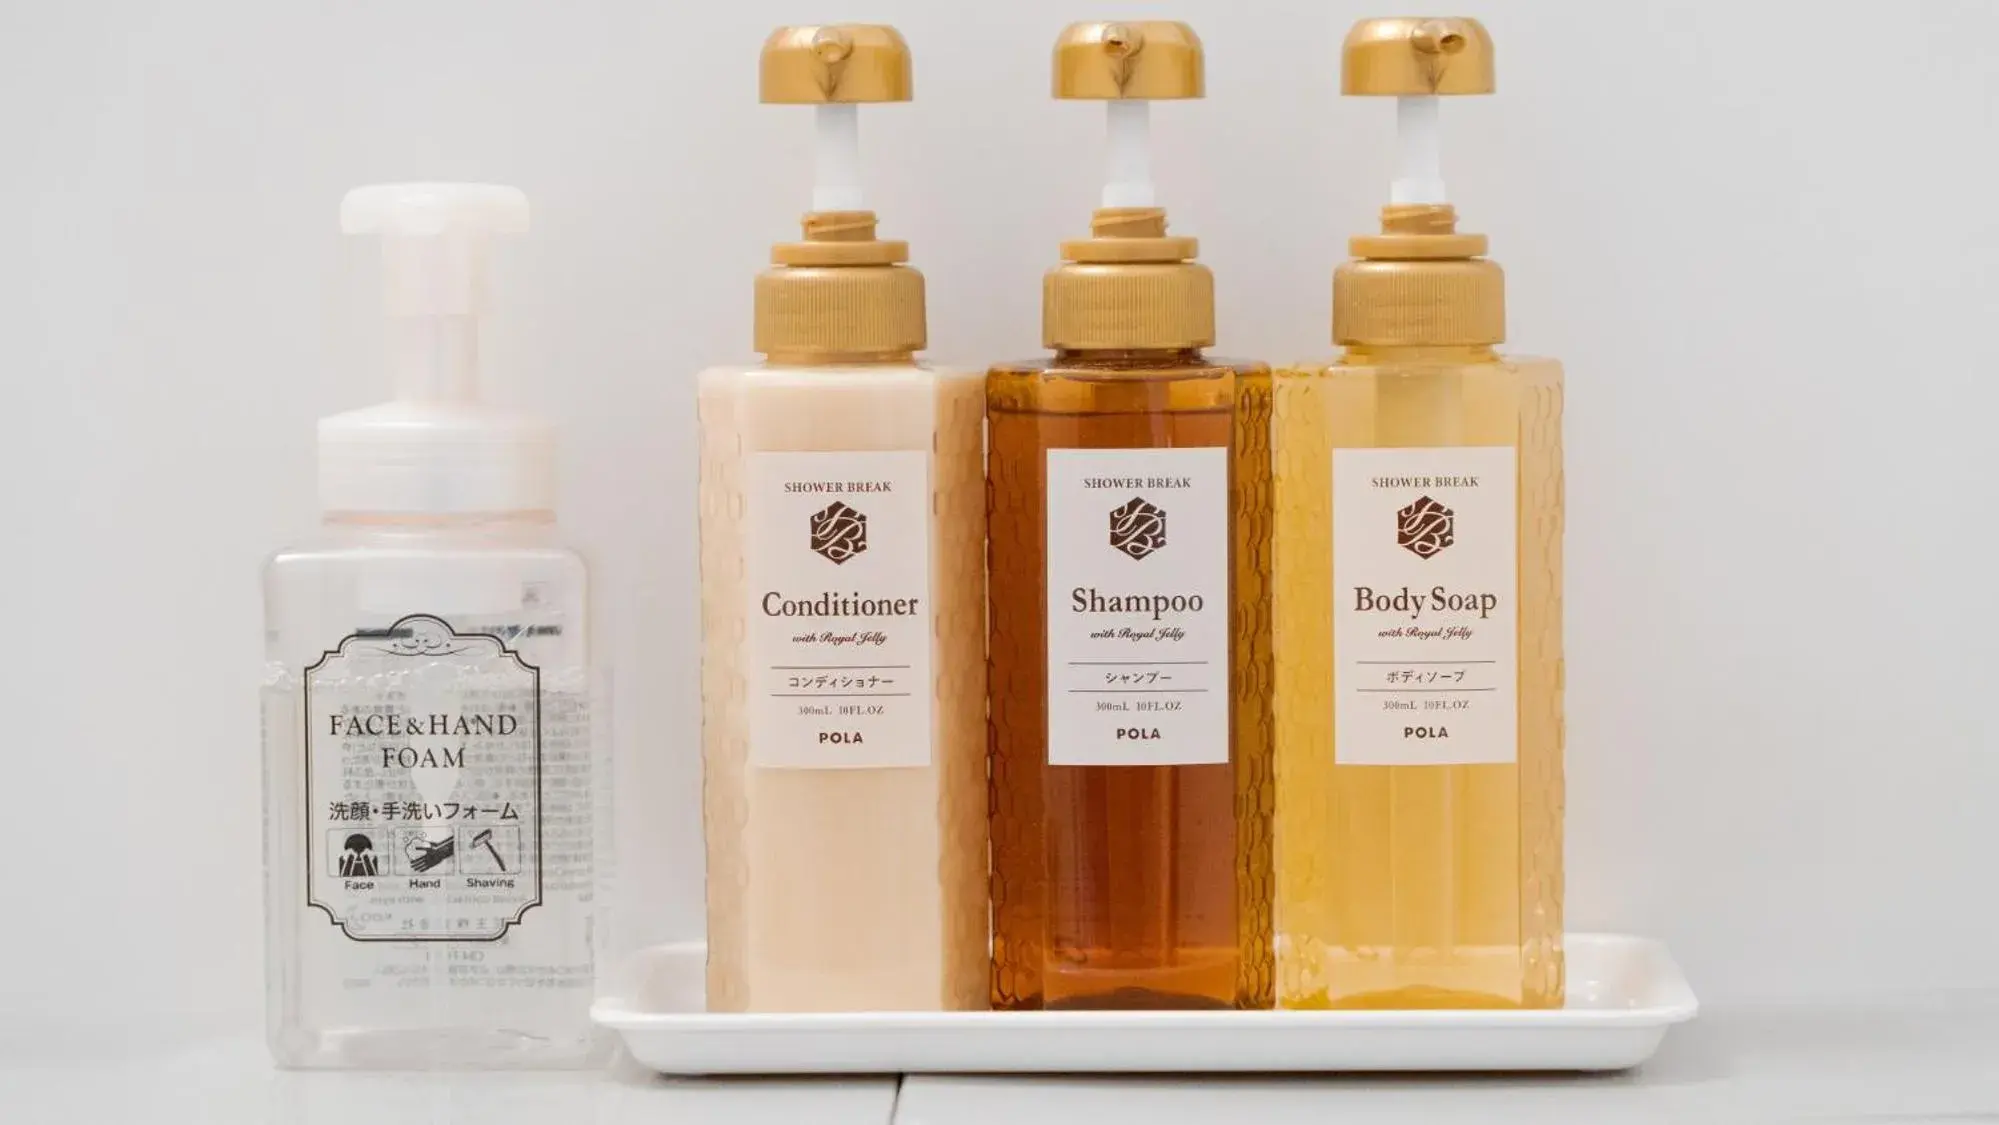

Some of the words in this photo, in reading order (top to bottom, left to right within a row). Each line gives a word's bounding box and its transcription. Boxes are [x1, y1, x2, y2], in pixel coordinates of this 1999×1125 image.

[784, 482, 844, 493] SHOWER
[847, 482, 892, 493] BREAK
[1083, 477, 1143, 489] SHOWER
[1147, 477, 1191, 489] BREAK
[1371, 477, 1431, 488] SHOWER
[1435, 476, 1479, 488] BREAK
[761, 591, 919, 617] Conditioner
[1072, 587, 1204, 621] Shampoo
[1353, 586, 1427, 619] Body
[1431, 586, 1498, 619] Soap
[792, 632, 817, 644] with
[818, 631, 856, 647] Royal
[856, 631, 888, 647] Jelly
[1090, 628, 1115, 640] with
[1117, 627, 1154, 642] Royal
[1154, 627, 1186, 642] Jelly
[1377, 627, 1403, 639] with
[1404, 626, 1442, 641] Royal
[1442, 626, 1473, 641] Jelly
[788, 675, 895, 689] コンディショナー
[330, 714, 518, 737] FACE&HAND
[818, 731, 864, 745] POLA
[1116, 727, 1162, 741] POLA
[1403, 726, 1449, 740] POLA
[381, 746, 466, 769] FOAM
[329, 801, 520, 822] 洗顔・手洗いフォーム
[344, 880, 375, 891] Face
[408, 879, 441, 890] Hand
[465, 877, 516, 890] Shaving
